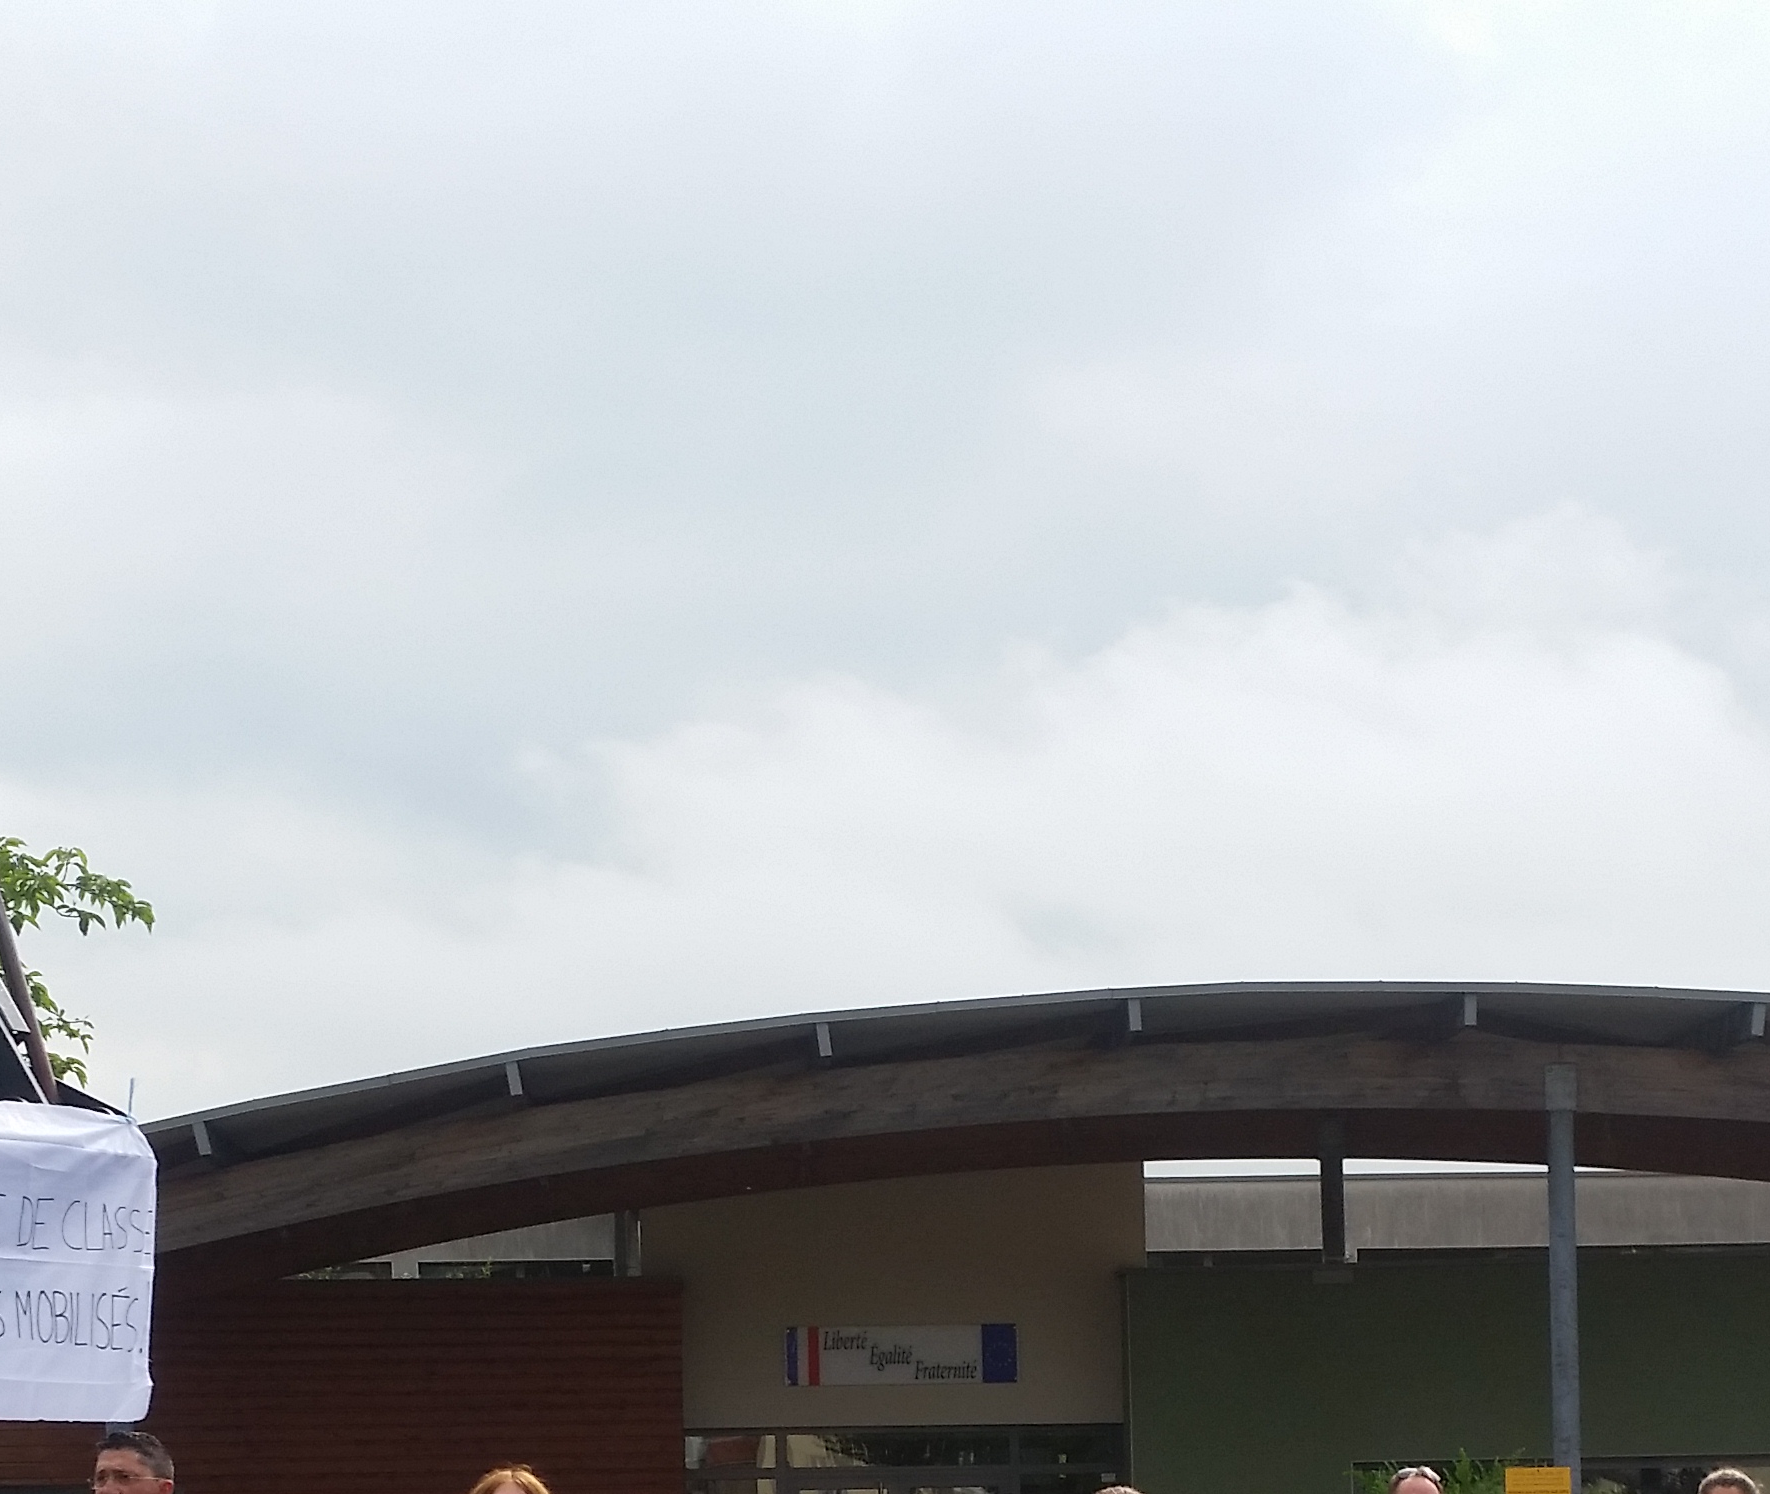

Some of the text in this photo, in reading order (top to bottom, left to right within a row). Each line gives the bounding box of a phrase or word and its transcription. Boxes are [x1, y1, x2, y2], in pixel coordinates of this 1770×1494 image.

[17, 1195, 55, 1251] DE
[824, 1331, 867, 1350] Liberté
[915, 1360, 977, 1380] Fraternité
